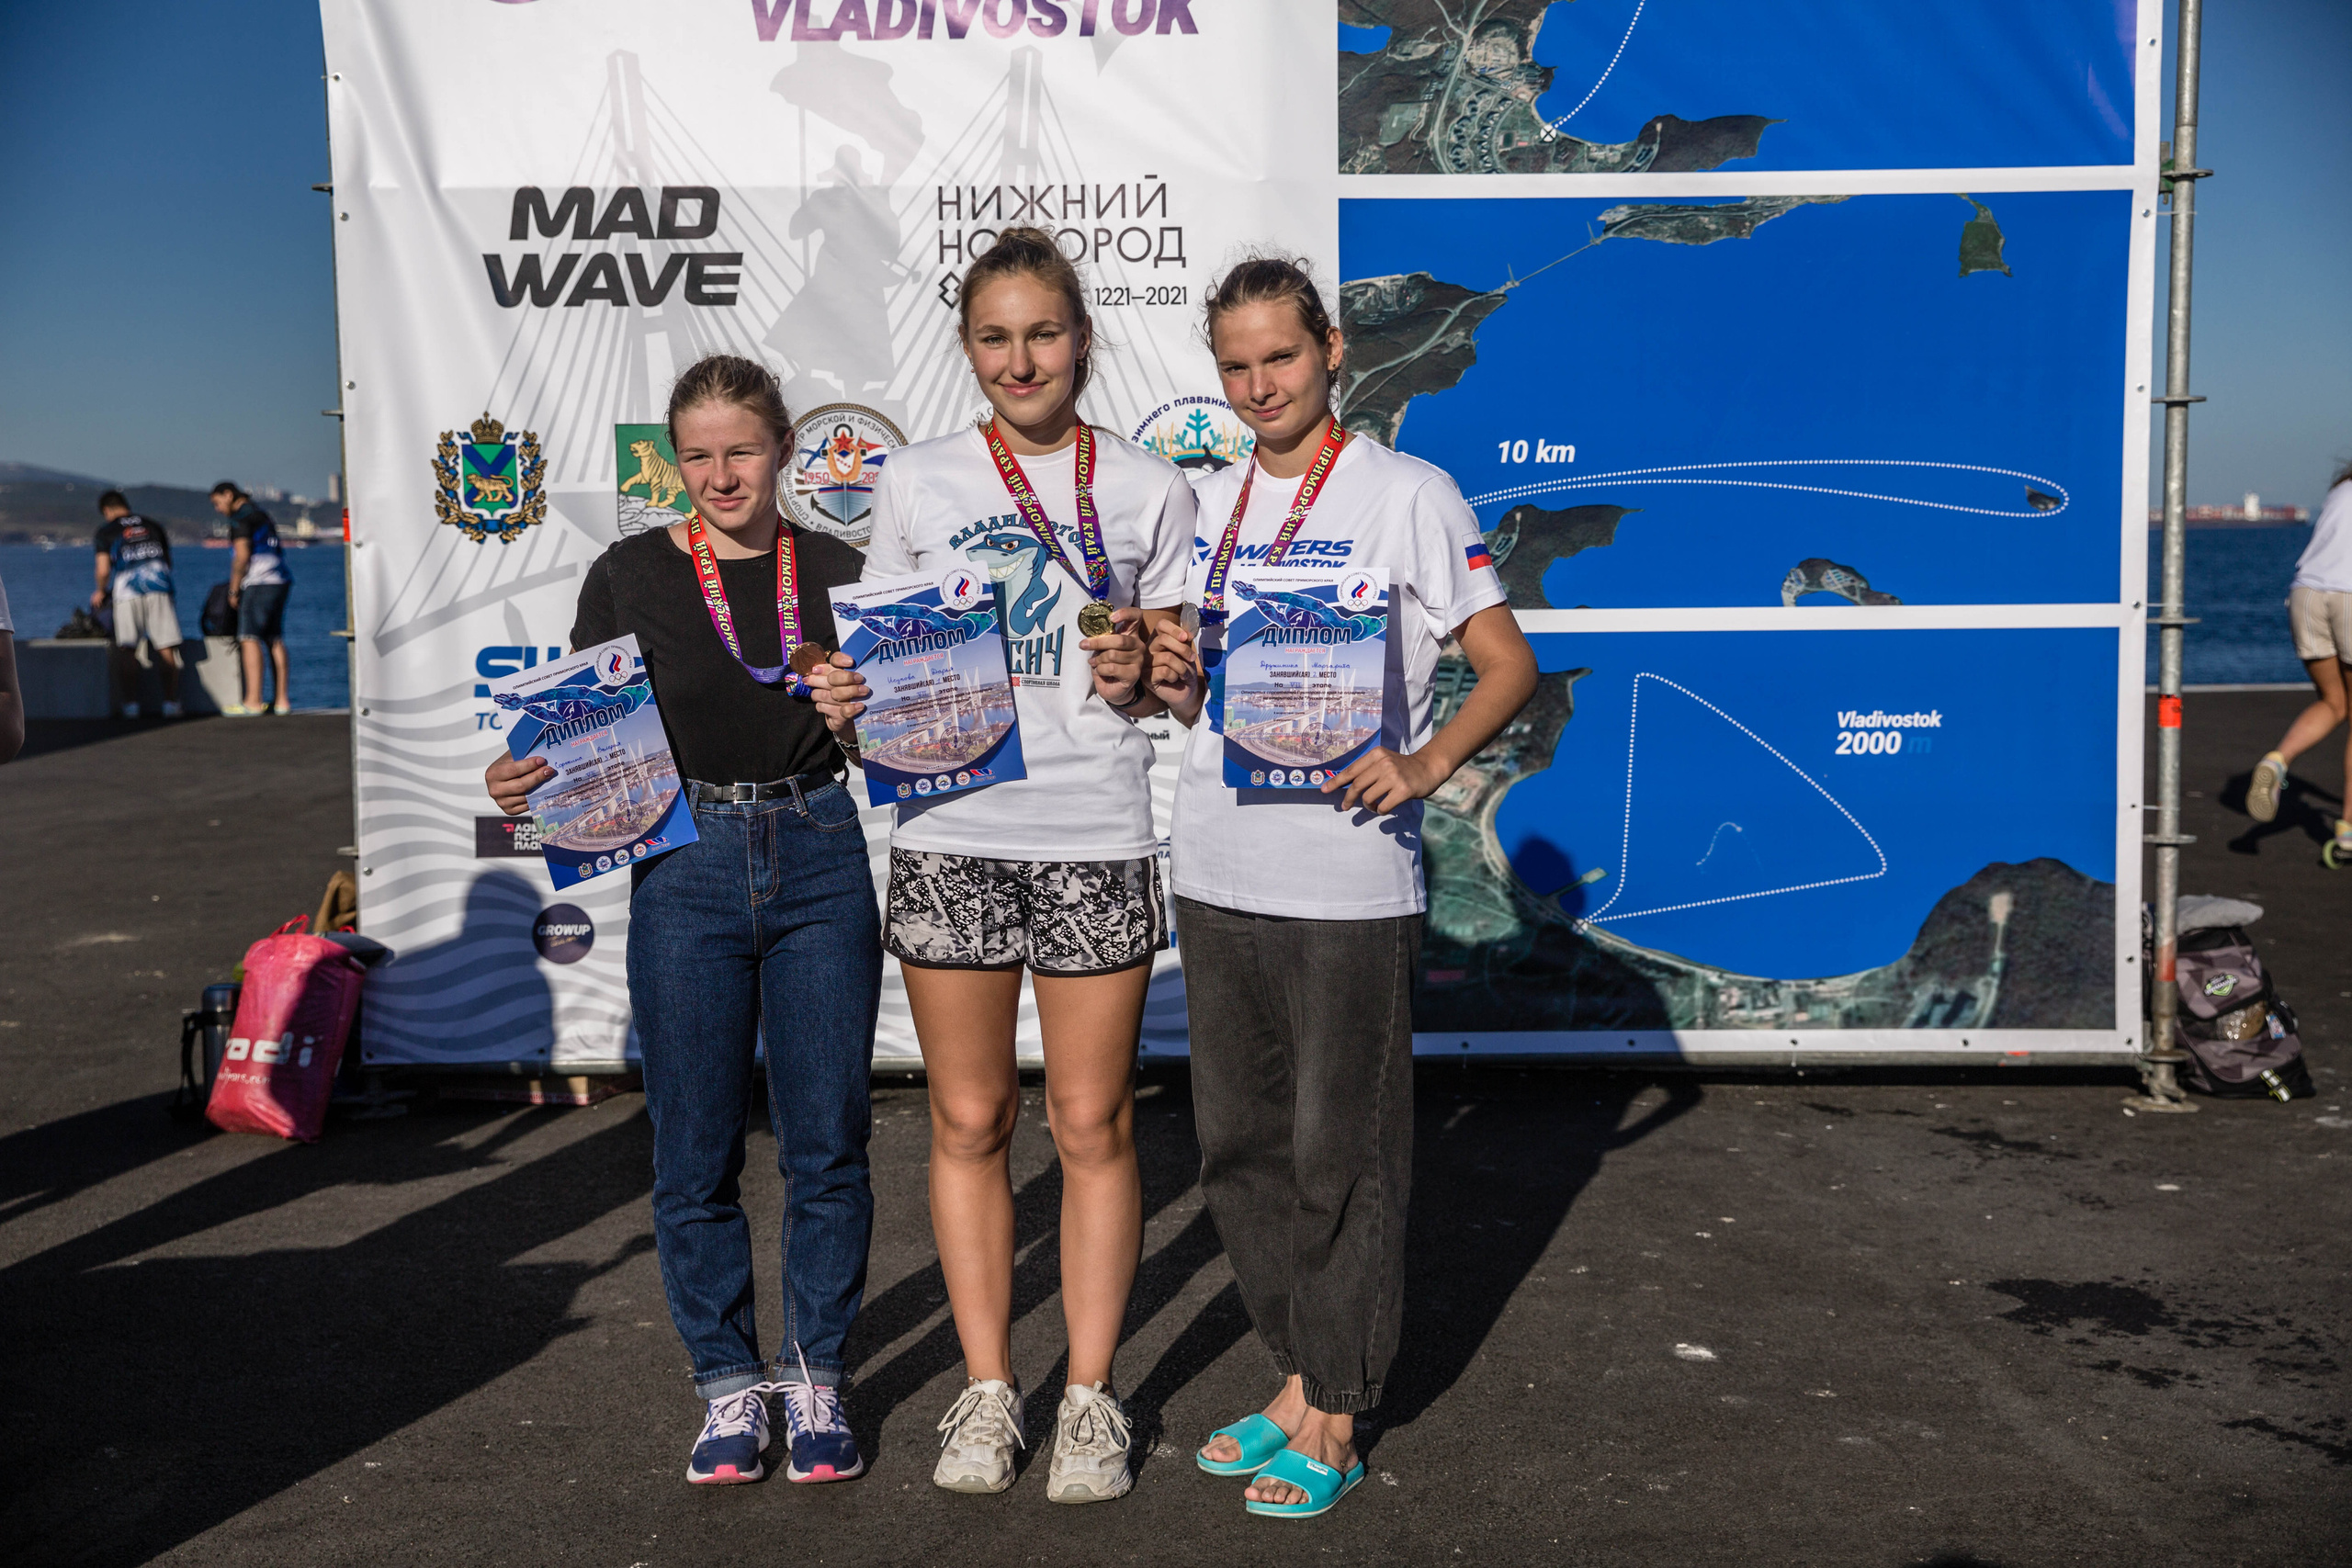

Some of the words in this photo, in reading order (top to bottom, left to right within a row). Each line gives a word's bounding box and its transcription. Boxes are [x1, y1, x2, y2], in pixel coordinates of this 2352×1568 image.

[751, 0, 1199, 41] VLADIVOSTOK
[509, 186, 720, 241] MAD
[938, 175, 1167, 220] НИЖНИЙ
[939, 227, 1186, 269] НООРОД
[482, 253, 743, 309] WAVE
[807, 413, 846, 434] МОРСКОЙ
[857, 417, 898, 449] ФИЗИЧЕСК
[1131, 404, 1170, 443] зимнего
[1174, 396, 1231, 412] плавания
[990, 437, 1015, 474] КРАЙ
[1498, 439, 1529, 464] 10
[1535, 438, 1576, 463] km
[803, 471, 830, 485] 1950
[1077, 425, 1096, 518] ПРИМОРСКИЙ
[1279, 445, 1334, 543] ПРИМОРСКИЙ
[815, 523, 871, 538] ВЛАДИВОСТО
[1006, 472, 1061, 555] ПРИМОРСКИЙ
[1082, 522, 1102, 556] КРАЙ
[694, 540, 715, 576] КРАЙ
[782, 536, 799, 630] ПРИМОРСКИЙ
[853, 591, 882, 601] ОЛИМПИЙСКИЙ
[895, 583, 923, 592] ПРИМОРСКОГО
[704, 579, 741, 660] РИМОРСКИЙ
[1261, 627, 1351, 648] ДИПЛОМ
[877, 628, 967, 665] ДИПЛОМ
[938, 685, 958, 694] этапе
[943, 673, 961, 683] МЕСТО
[545, 703, 628, 750] ДИПЛОМ
[1838, 709, 1943, 728] Vladivostok
[609, 748, 627, 760] МЕСТО
[1835, 730, 1903, 755] 2000
[607, 761, 625, 772] этапе
[537, 924, 591, 936] GROWUP
